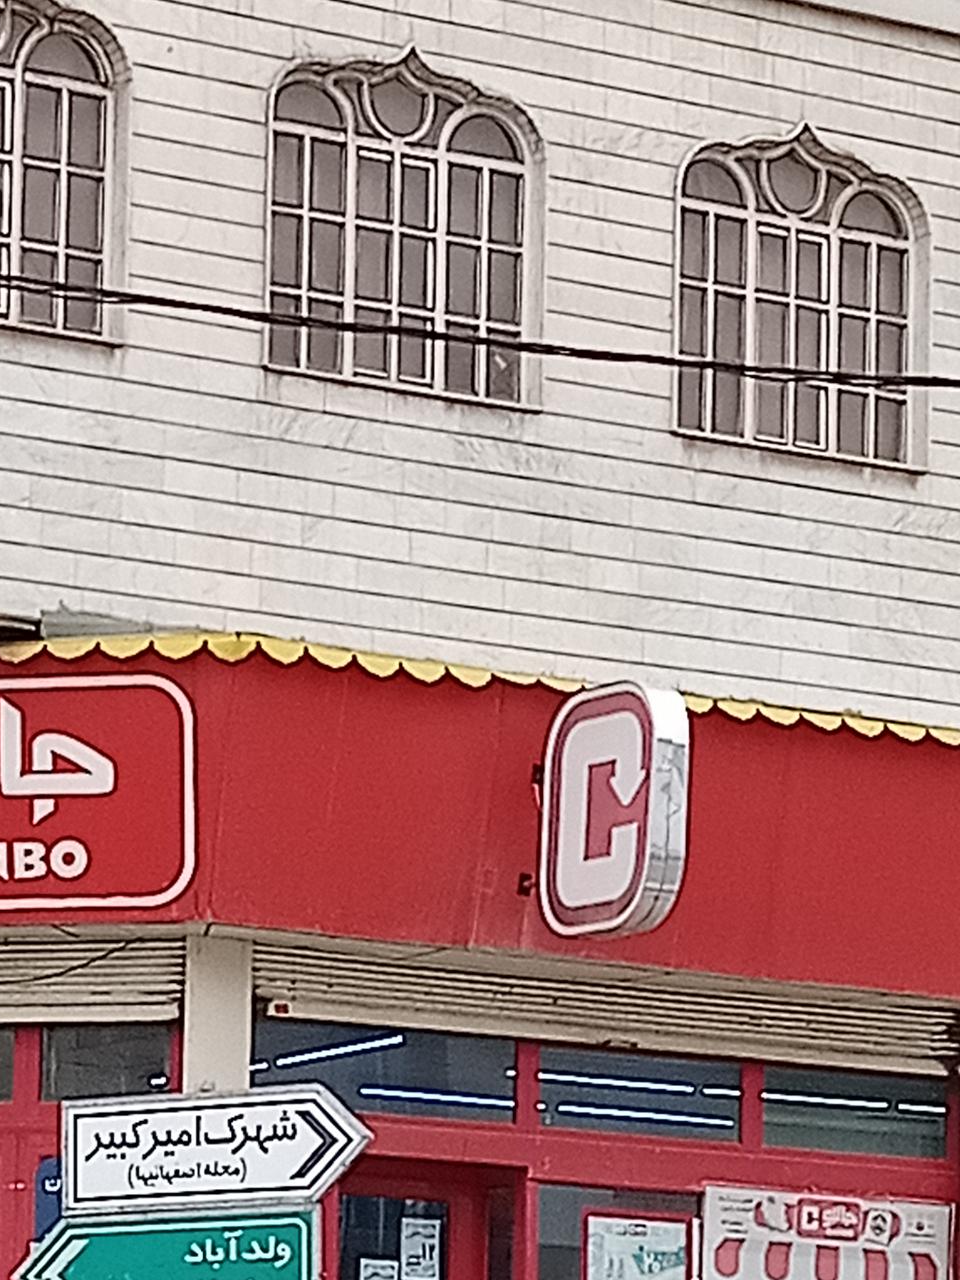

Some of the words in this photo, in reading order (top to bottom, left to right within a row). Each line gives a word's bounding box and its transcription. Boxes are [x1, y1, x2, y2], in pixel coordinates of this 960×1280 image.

[204, 1110, 297, 1155] شهرک
[184, 1230, 244, 1270] آباد
[241, 1235, 292, 1268] ولد
